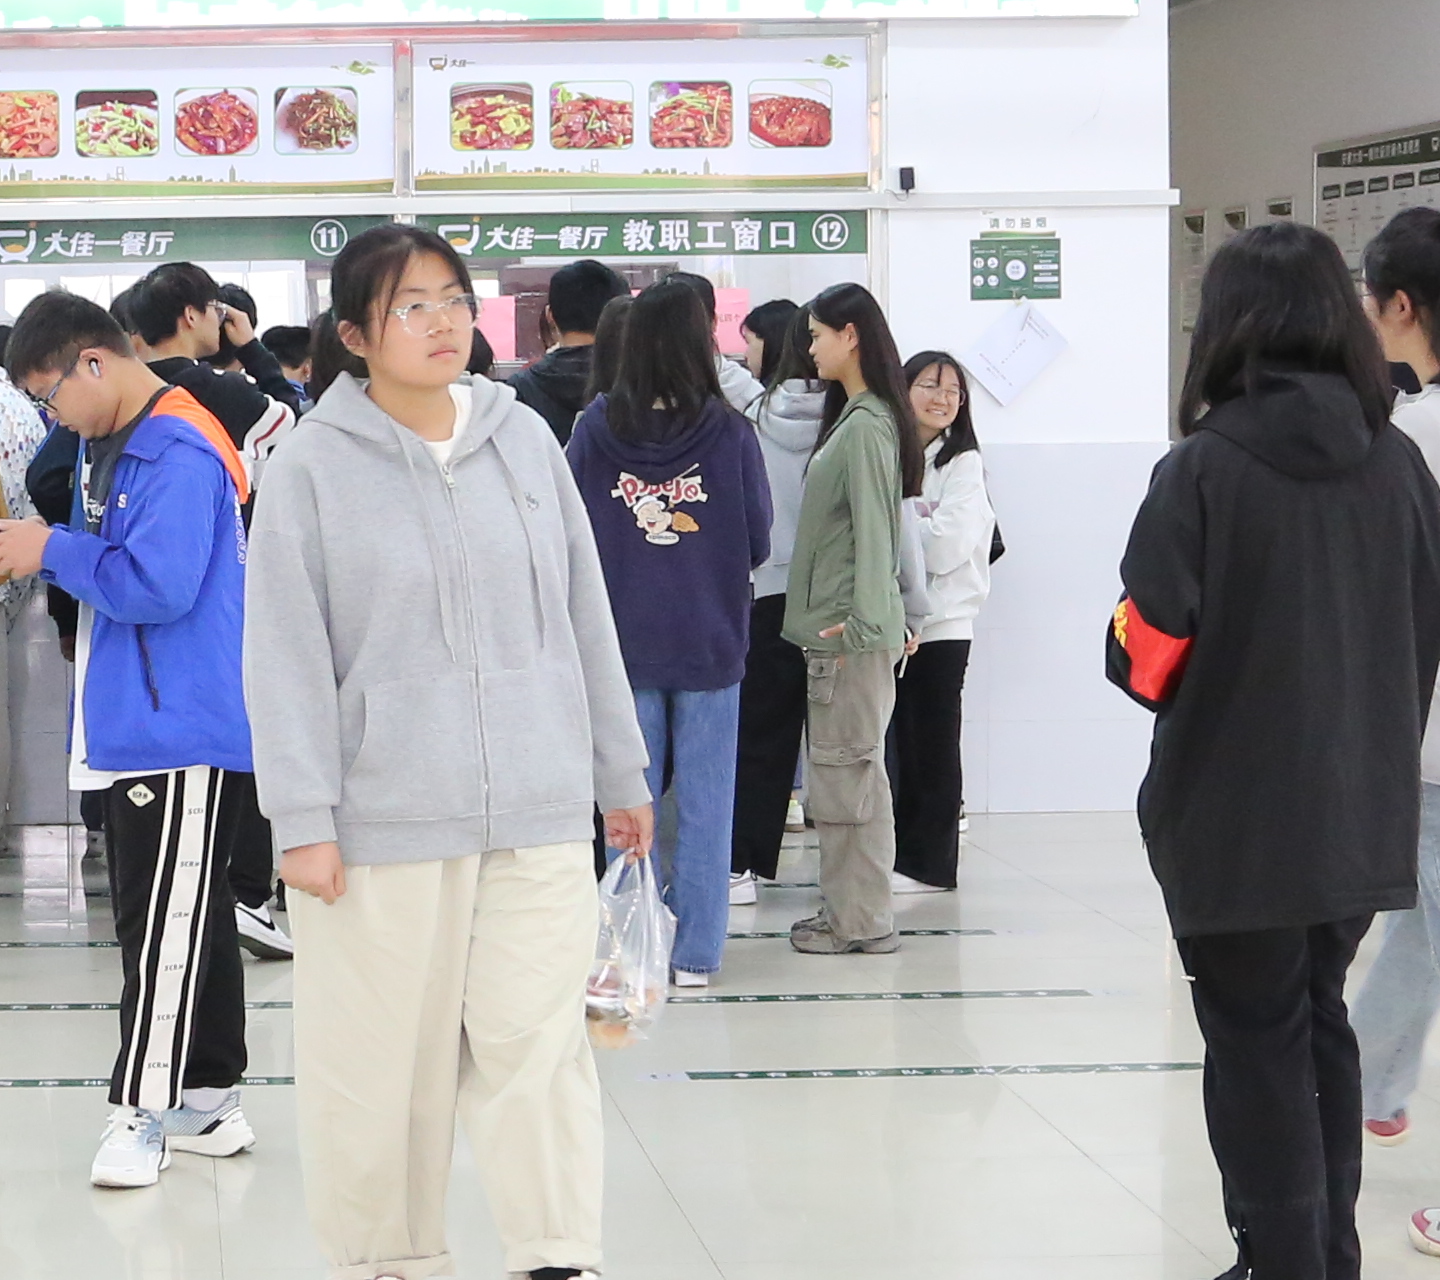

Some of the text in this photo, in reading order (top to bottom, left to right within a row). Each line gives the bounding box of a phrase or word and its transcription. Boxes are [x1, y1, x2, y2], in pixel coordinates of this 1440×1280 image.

[41, 229, 175, 257] 大佳一餐厅
[484, 218, 841, 253] 大佳一餐厅 教职工窗口 12
